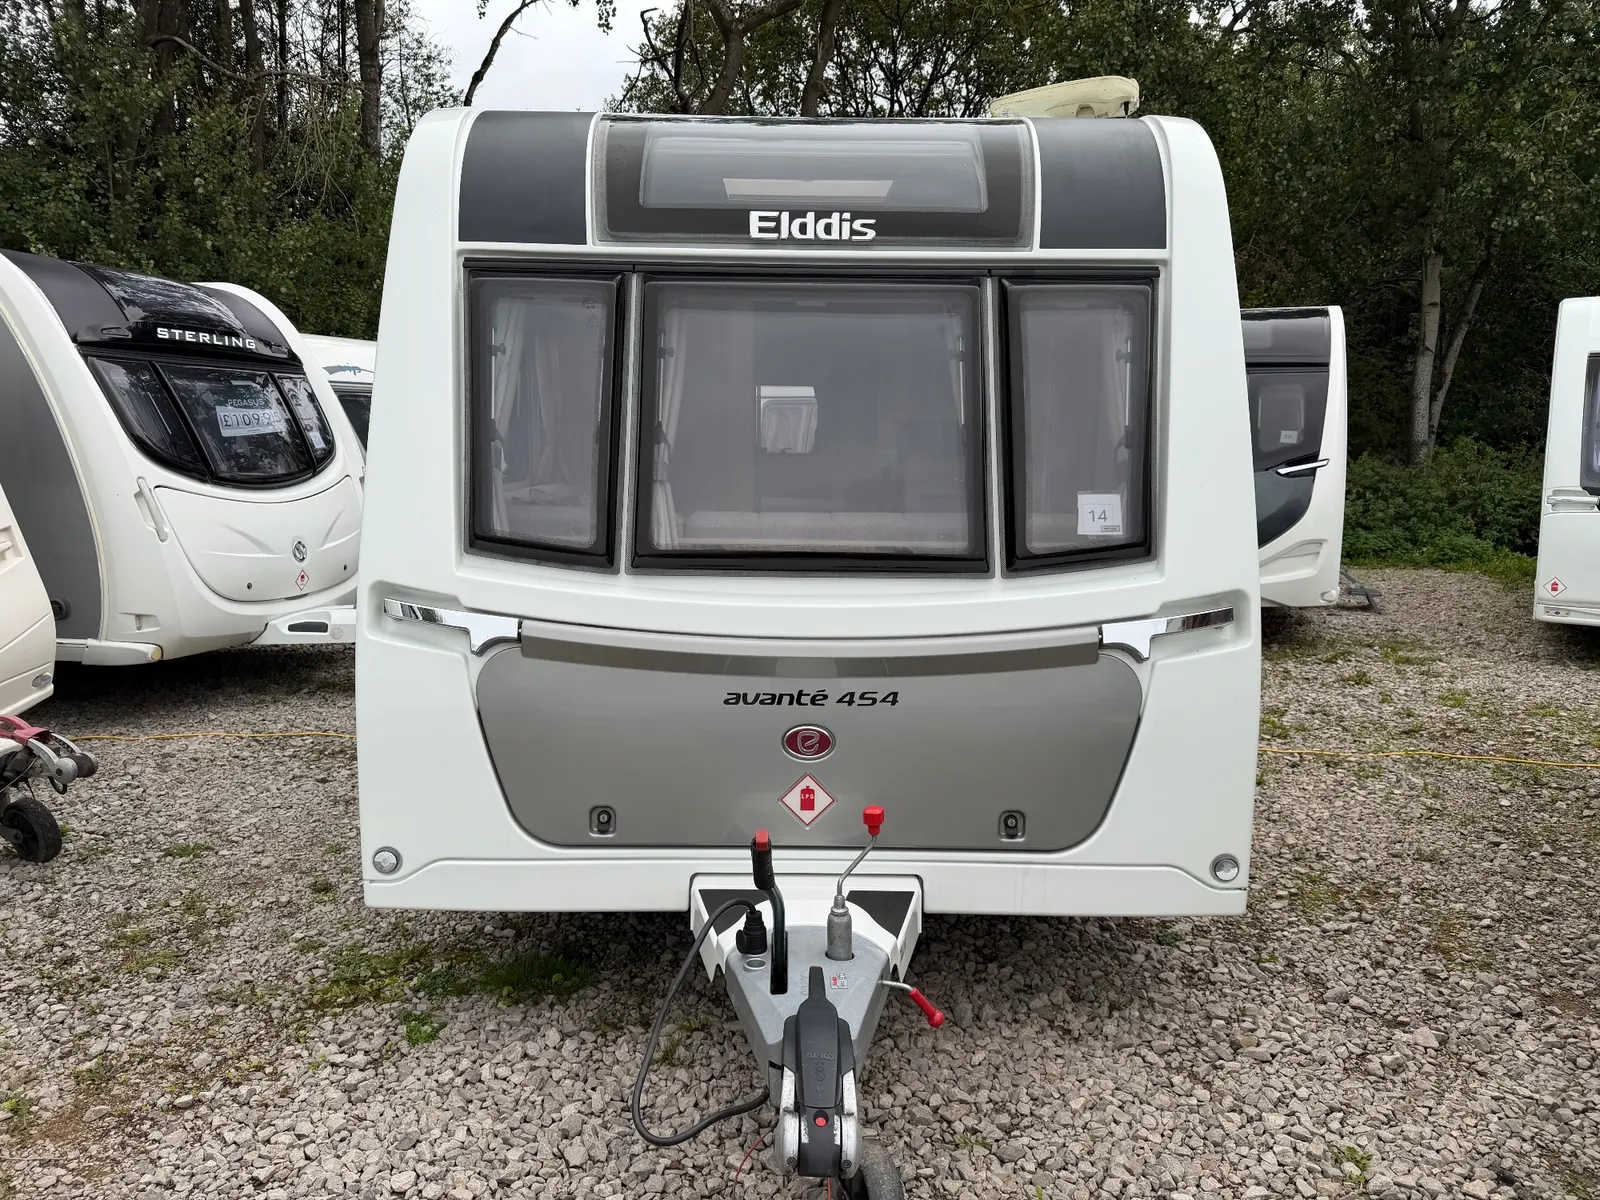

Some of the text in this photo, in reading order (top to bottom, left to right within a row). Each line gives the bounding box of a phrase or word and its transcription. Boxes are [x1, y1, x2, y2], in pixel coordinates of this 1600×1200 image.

[749, 210, 877, 241] Elddis
[156, 327, 256, 349] STERLING
[227, 398, 265, 408] PEGASUS
[1088, 509, 1108, 522] 14
[723, 689, 899, 707] avanté 454
